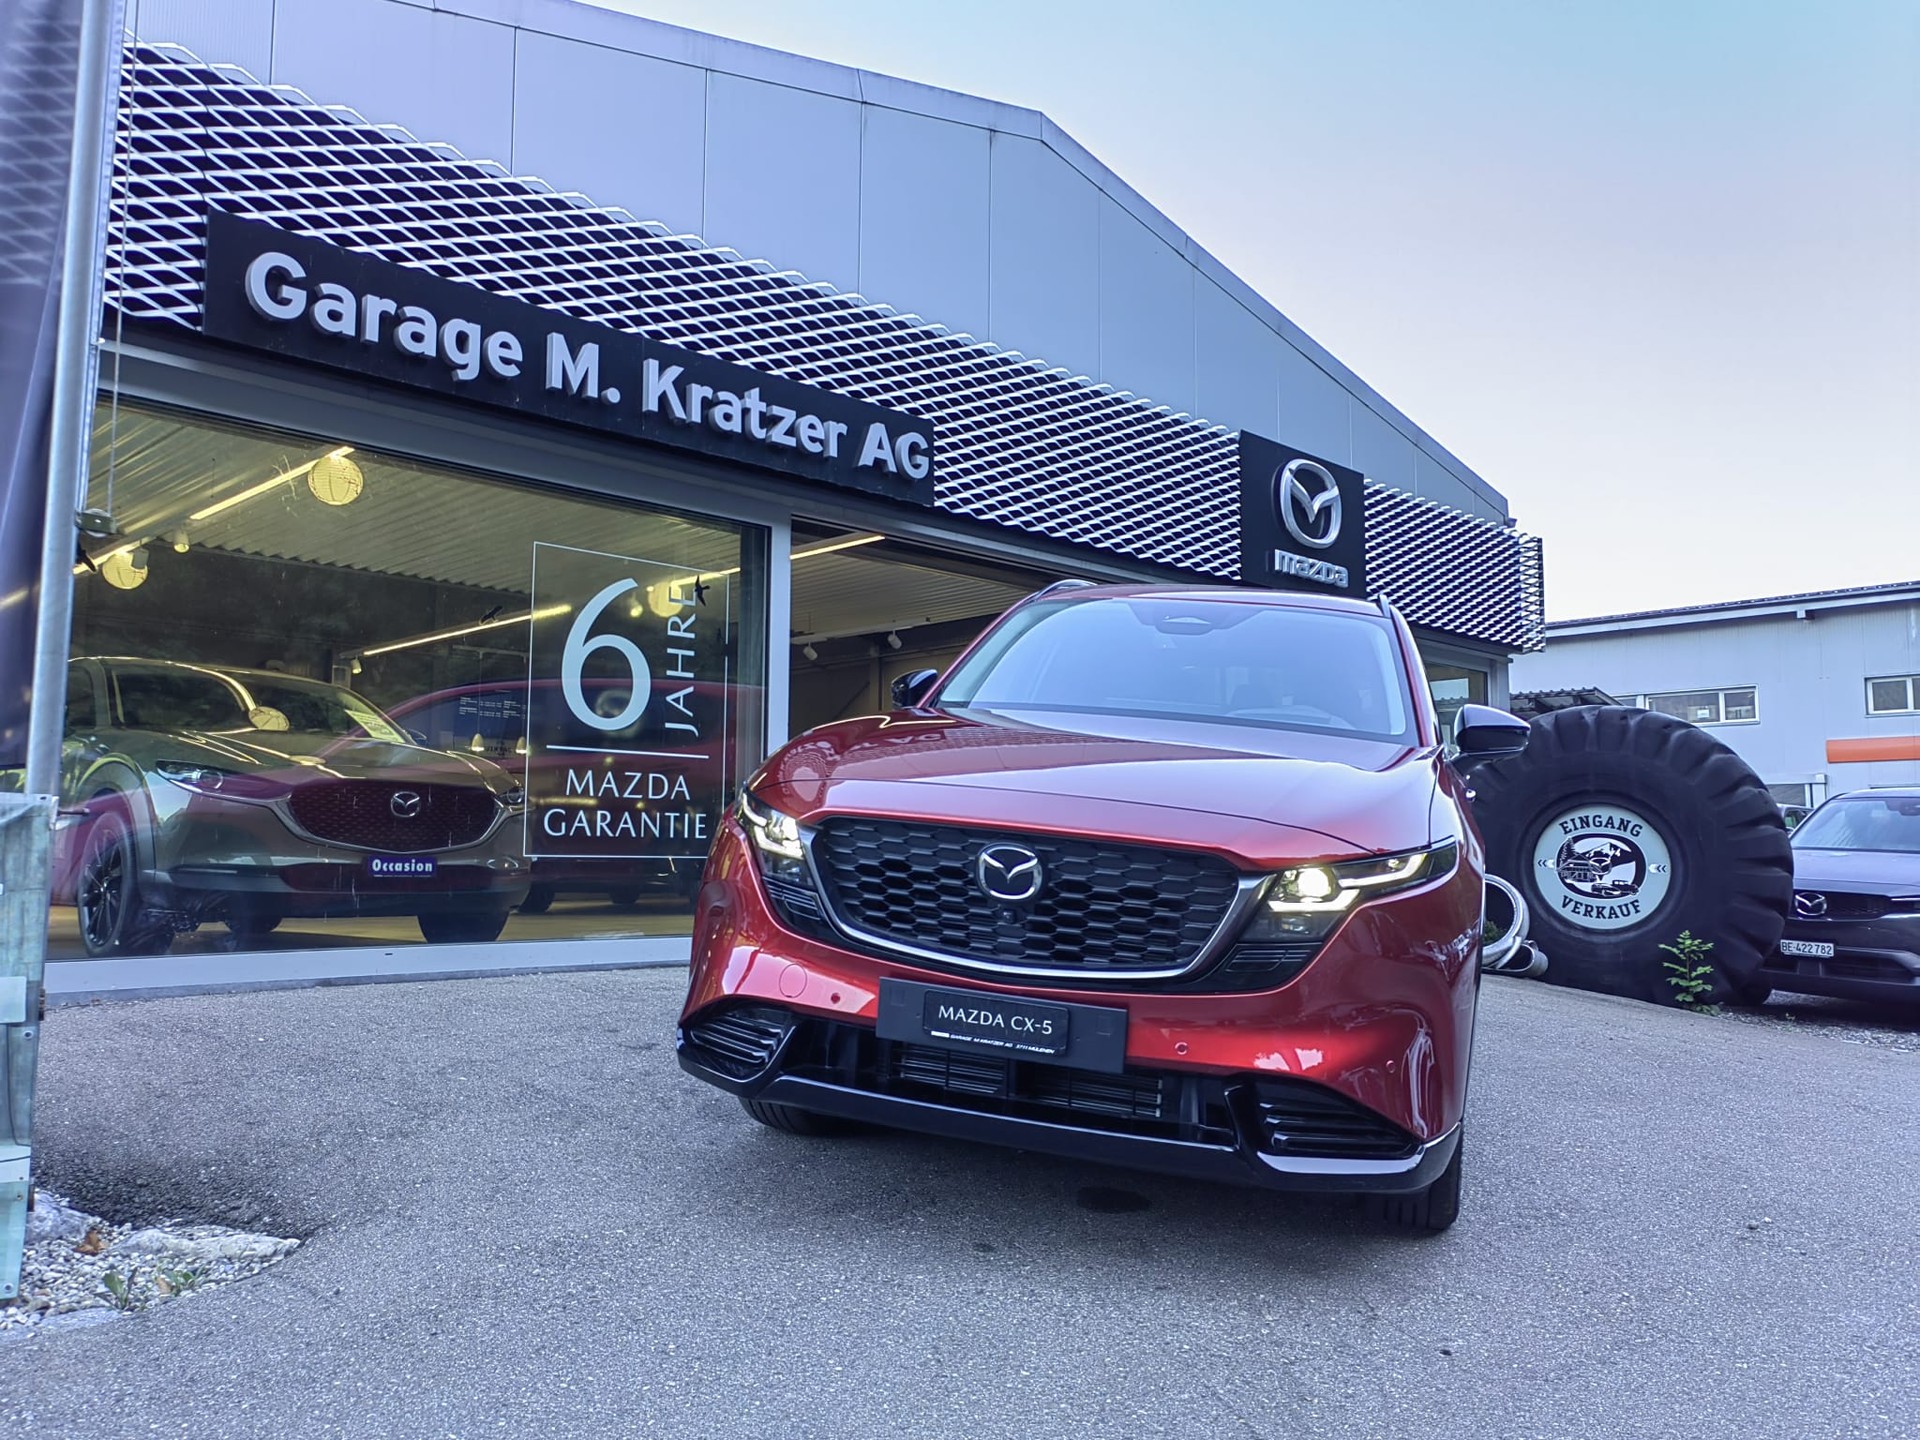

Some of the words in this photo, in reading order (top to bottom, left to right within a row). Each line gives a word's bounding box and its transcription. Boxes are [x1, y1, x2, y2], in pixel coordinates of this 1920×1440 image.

[245, 252, 523, 381] Garage
[546, 332, 621, 404] M.
[642, 358, 848, 458] Kratzer
[858, 422, 930, 480] AG
[561, 577, 651, 731] 6
[665, 583, 699, 738] JAHRE
[566, 768, 691, 801] MAZDA
[543, 808, 708, 840] GARANTIE
[1559, 814, 1643, 837] EINGANG
[372, 859, 433, 872] Occasion
[1561, 895, 1641, 919] VERKAUF
[938, 1005, 1005, 1028] MAZDA
[1010, 1015, 1052, 1035] CX-5
